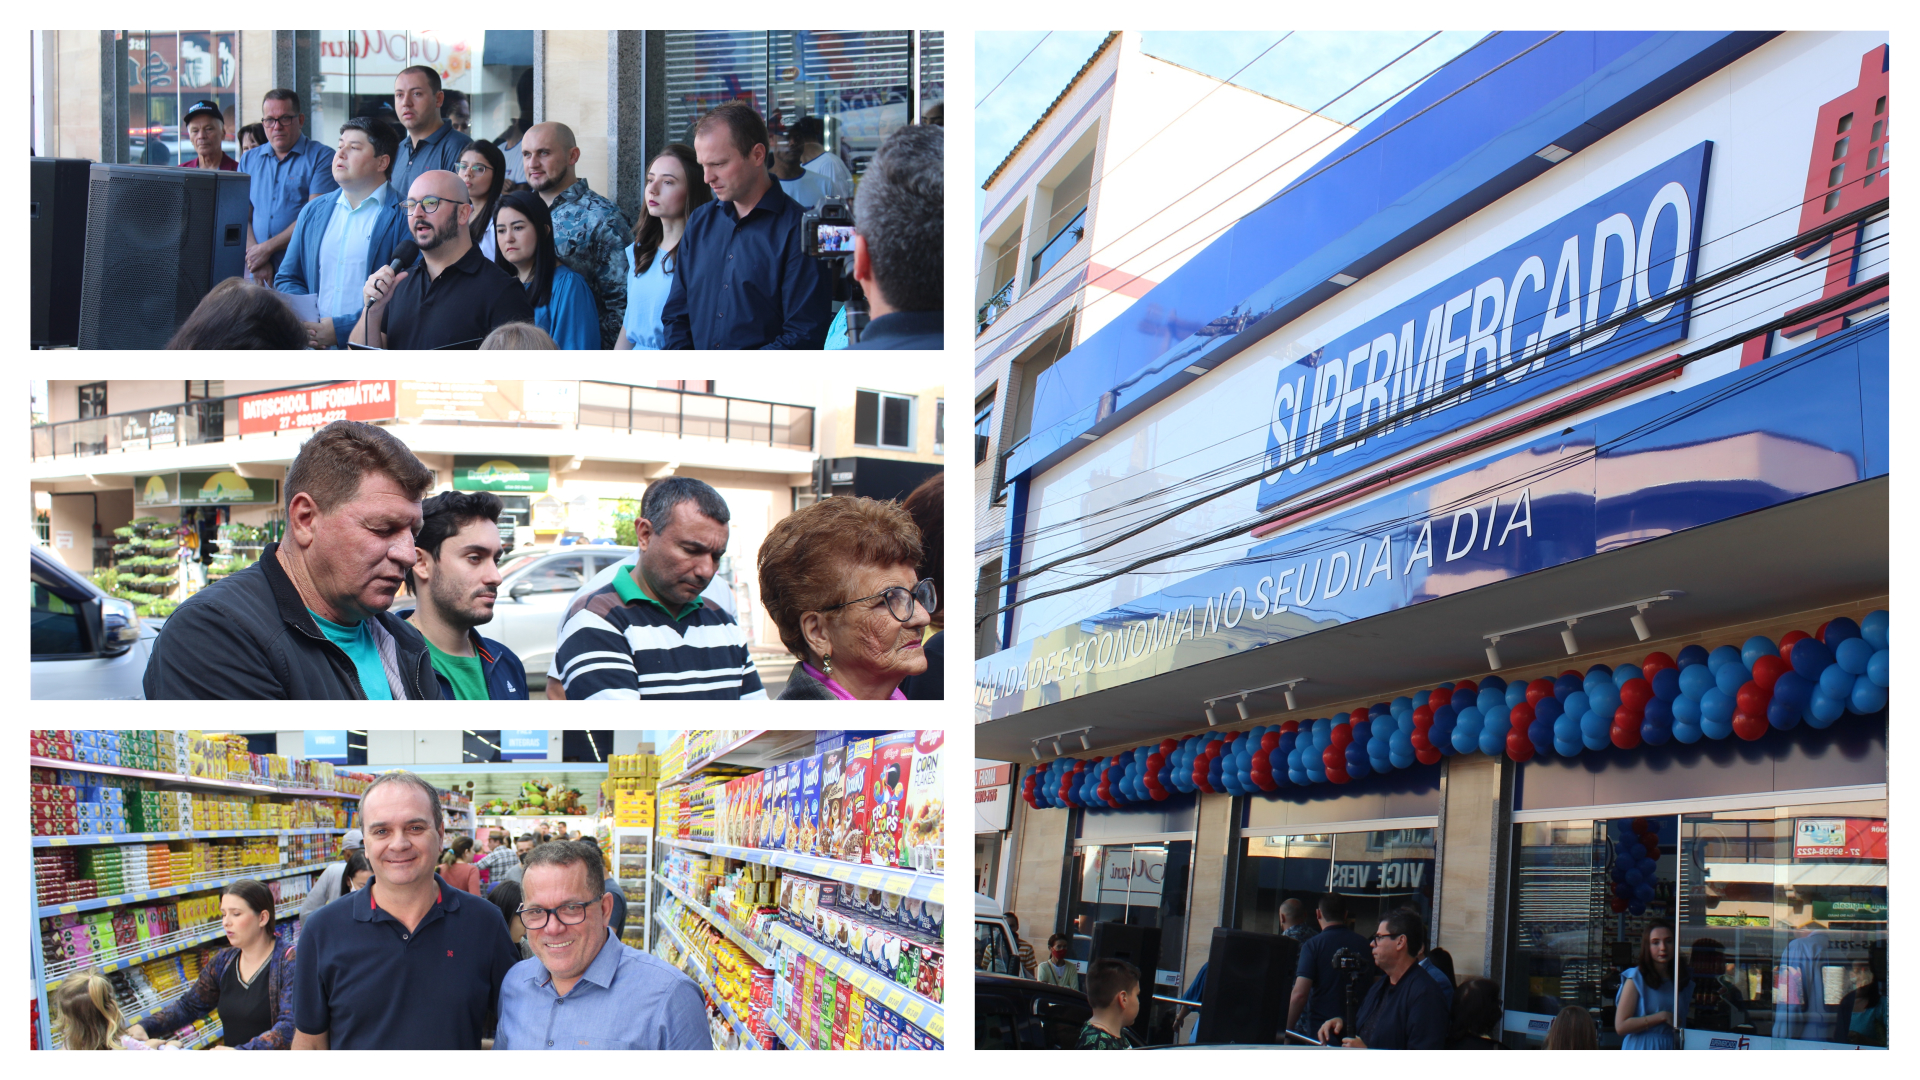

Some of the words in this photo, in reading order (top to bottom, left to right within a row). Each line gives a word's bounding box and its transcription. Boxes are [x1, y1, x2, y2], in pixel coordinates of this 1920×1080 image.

[1264, 182, 1691, 485] SUPERMERCADO
[311, 381, 390, 409] INFORMÁTICA
[279, 417, 291, 429] 27
[1070, 603, 1194, 677] ECONOMIA
[1200, 587, 1247, 637] NO
[1251, 557, 1323, 620] SEU
[1323, 535, 1393, 600] DIA
[1404, 520, 1434, 575] A
[1445, 487, 1533, 564] DIA
[916, 754, 938, 773] CORN
[914, 771, 936, 787] FLAKES
[872, 801, 898, 823] FROOT
[874, 816, 898, 833] LOOPS
